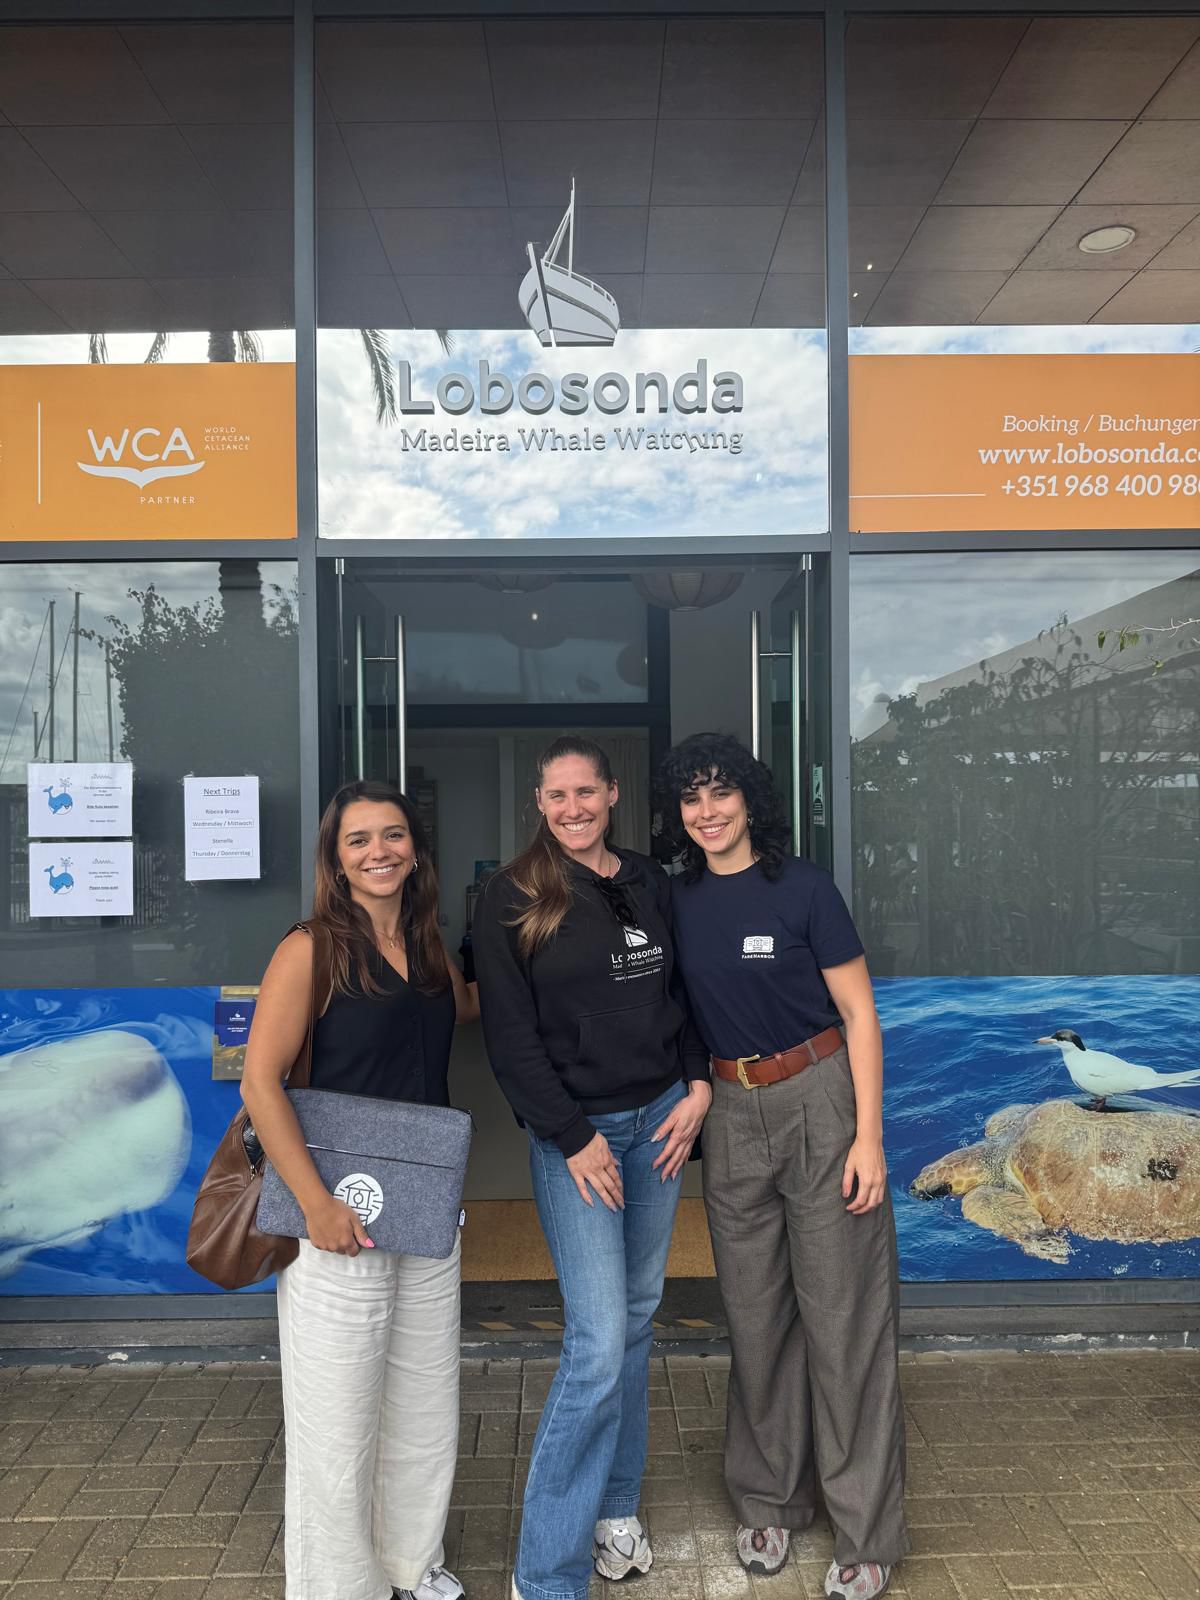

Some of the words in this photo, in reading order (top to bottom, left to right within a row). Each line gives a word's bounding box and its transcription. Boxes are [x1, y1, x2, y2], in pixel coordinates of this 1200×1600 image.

[400, 359, 744, 415] Lobosonda
[1002, 415, 1080, 435] Booking
[1083, 414, 1095, 433] /
[87, 427, 195, 462] WCA
[204, 443, 249, 451] ALLIANCE
[400, 428, 510, 452] Madeira
[518, 427, 606, 451] Whale
[978, 442, 1200, 465] www.lobosonda.c
[1001, 475, 1059, 497] +351
[1064, 475, 1109, 497] 968
[1115, 474, 1162, 497] 400
[1168, 474, 1200, 497] 98
[140, 496, 196, 505] PARTNER
[222, 788, 241, 797] Trips
